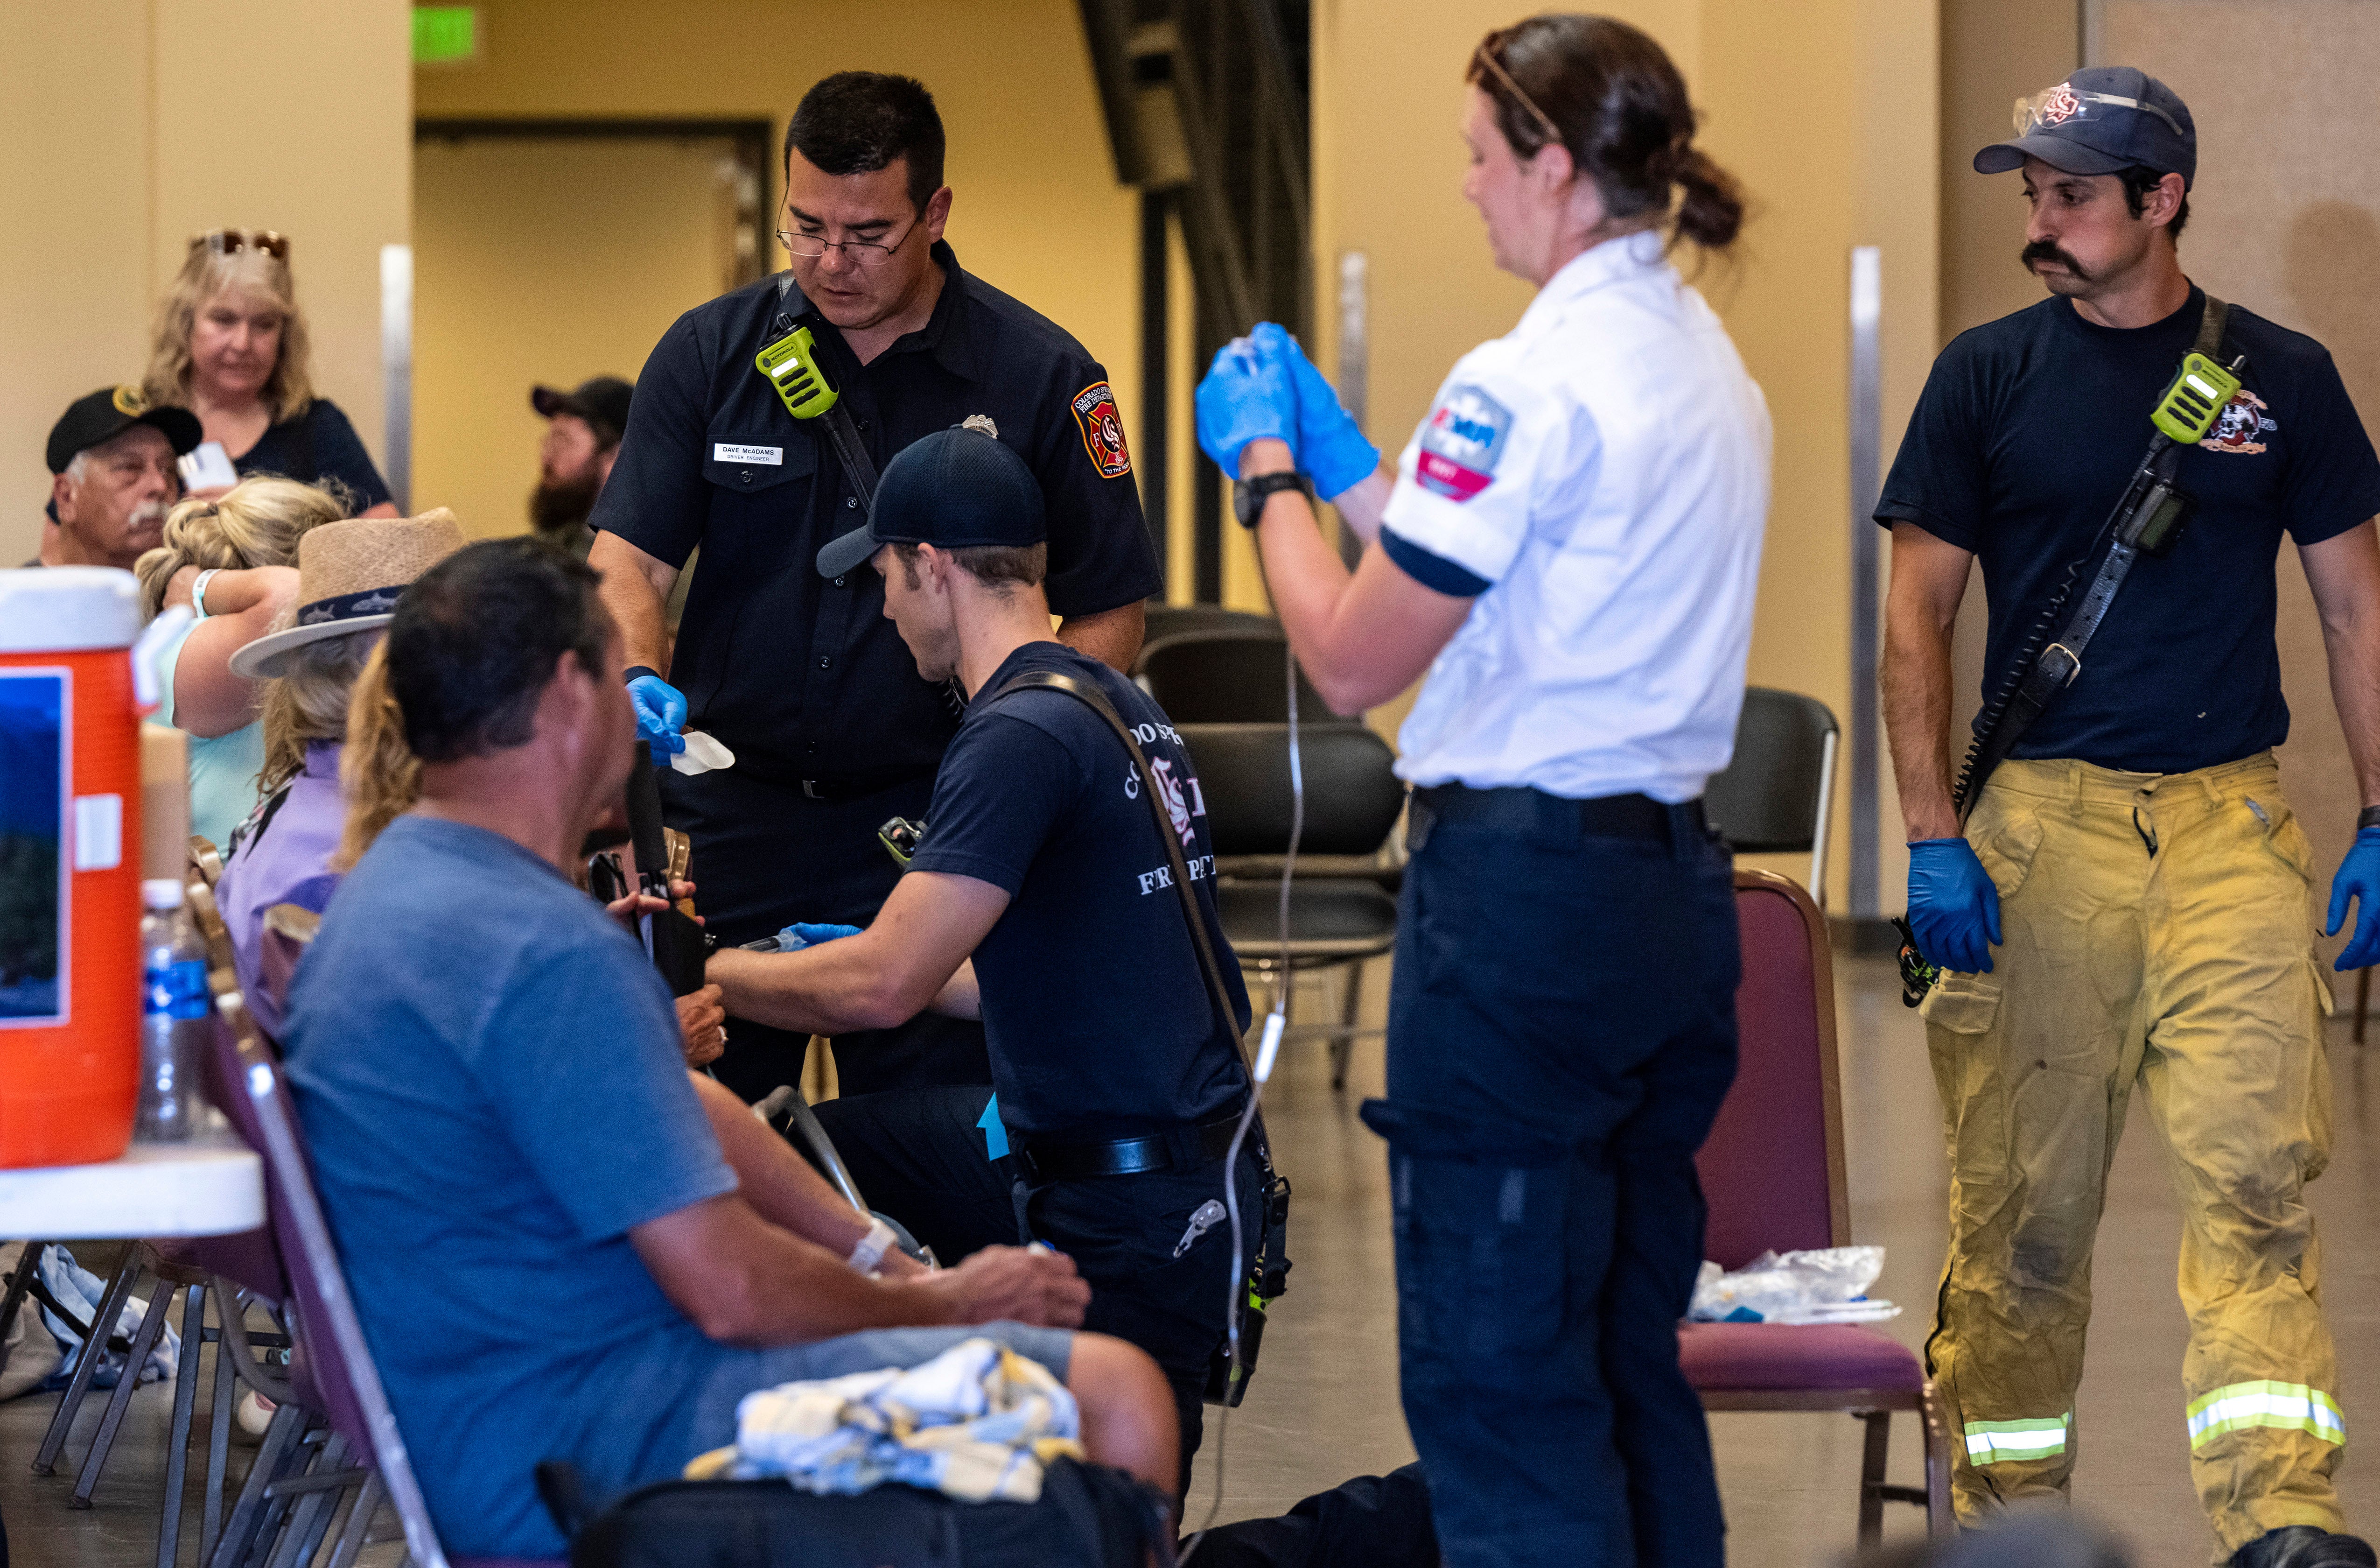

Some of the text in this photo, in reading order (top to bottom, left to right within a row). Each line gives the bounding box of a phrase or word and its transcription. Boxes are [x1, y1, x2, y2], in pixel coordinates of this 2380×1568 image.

[771, 346, 794, 361] MOTOROLA
[1075, 388, 1100, 408] COLORADO
[1079, 401, 1092, 414] FIRE
[1092, 432, 1099, 447] F
